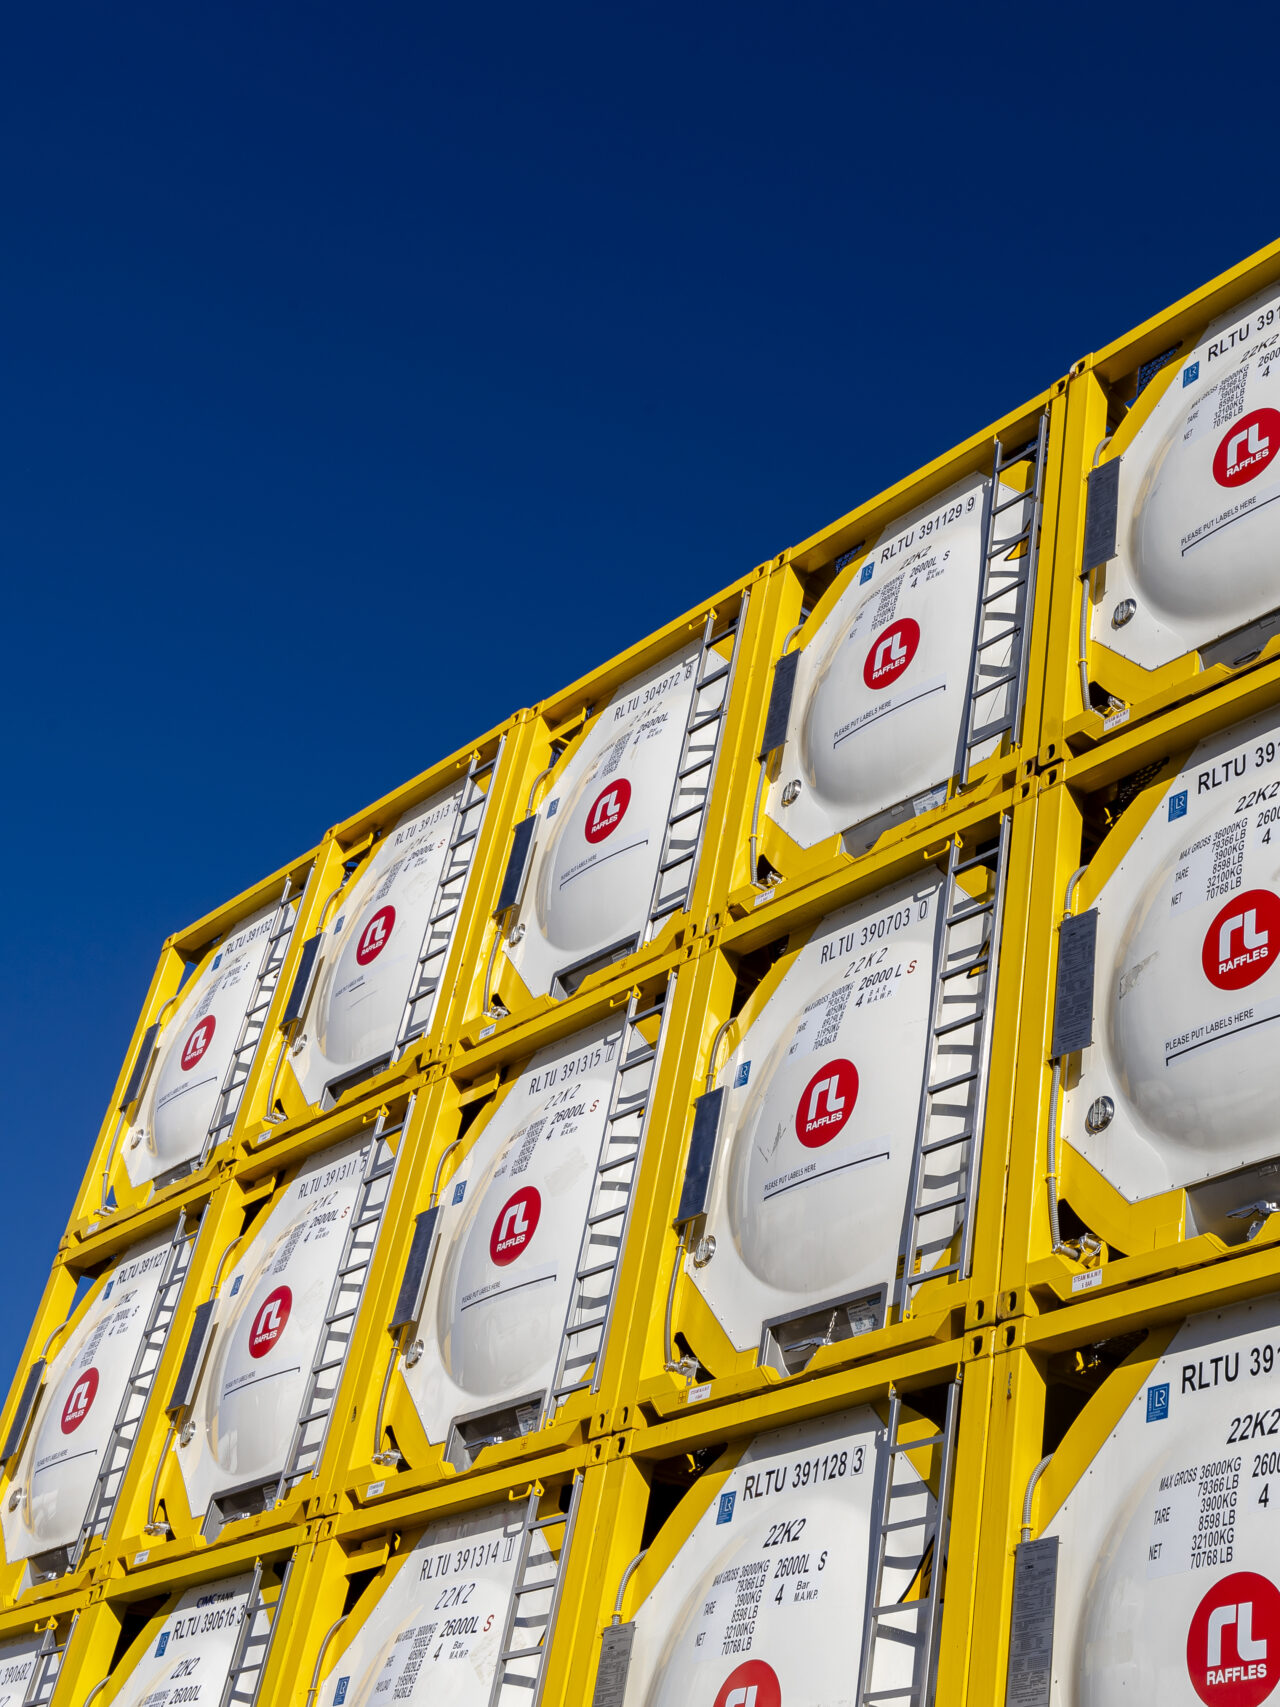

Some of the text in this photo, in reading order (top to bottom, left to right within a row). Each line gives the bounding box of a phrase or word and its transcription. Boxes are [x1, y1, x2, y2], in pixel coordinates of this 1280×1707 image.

[1208, 324, 1250, 362] RLTU
[1240, 333, 1279, 363] 22K2
[1262, 365, 1270, 377] 4
[1227, 448, 1269, 478] RAFFLES
[880, 503, 962, 564] RLTU 391129
[1181, 496, 1257, 546] PLEASE PUT LABELS HERE
[872, 657, 905, 680] RAFFLES
[614, 672, 680, 721] RLTU 304972
[1198, 755, 1247, 794] RLTU
[1234, 781, 1280, 814] 22K2
[395, 805, 450, 846] RLTU 391313
[591, 815, 617, 833] RAFFLES
[1213, 818, 1248, 842] 36000KG
[1262, 829, 1271, 844] 4
[1175, 840, 1244, 882] TARE 3900KG
[1171, 866, 1243, 907] NET 32100KG
[225, 937, 245, 956] RLTU
[821, 908, 910, 964] RLTU 390703
[844, 947, 888, 979] 22K2
[1219, 947, 1268, 974] RAFFLES
[858, 960, 917, 992] 26000 S
[856, 993, 863, 1007] 4
[1166, 1009, 1254, 1052] PLEASE PUT LABELS HERE
[529, 1049, 601, 1095] RLTU 391315
[590, 1100, 599, 1112] S
[806, 1112, 842, 1132] RAFFLES
[298, 1164, 356, 1199] RLTU 391311
[497, 1234, 525, 1252] RAFFLES
[117, 1251, 167, 1285] RLTU 391127
[254, 1330, 277, 1345] RAFFLES
[1182, 1352, 1240, 1393] RLTU
[743, 1448, 863, 1501] RLTU 391128 3
[1200, 1457, 1242, 1480] 36000KG
[1154, 1492, 1237, 1525] TARE 3900KG
[1258, 1483, 1269, 1508] 4
[762, 1519, 806, 1548] 22K2
[1149, 1528, 1235, 1560] NET 32100KG
[419, 1541, 500, 1582] RLTU 391314
[774, 1551, 827, 1579] 26000L S
[217, 1591, 235, 1601] TANK
[434, 1583, 476, 1611] 22K2
[774, 1584, 784, 1605] 4
[172, 1608, 235, 1641] RLTU 390616
[439, 1614, 494, 1638] 26000L S
[433, 1643, 443, 1661] 4
[1, 1662, 32, 1686] 390682
[171, 1657, 200, 1680] 22K2
[1207, 1664, 1267, 1686] RAFFLES
